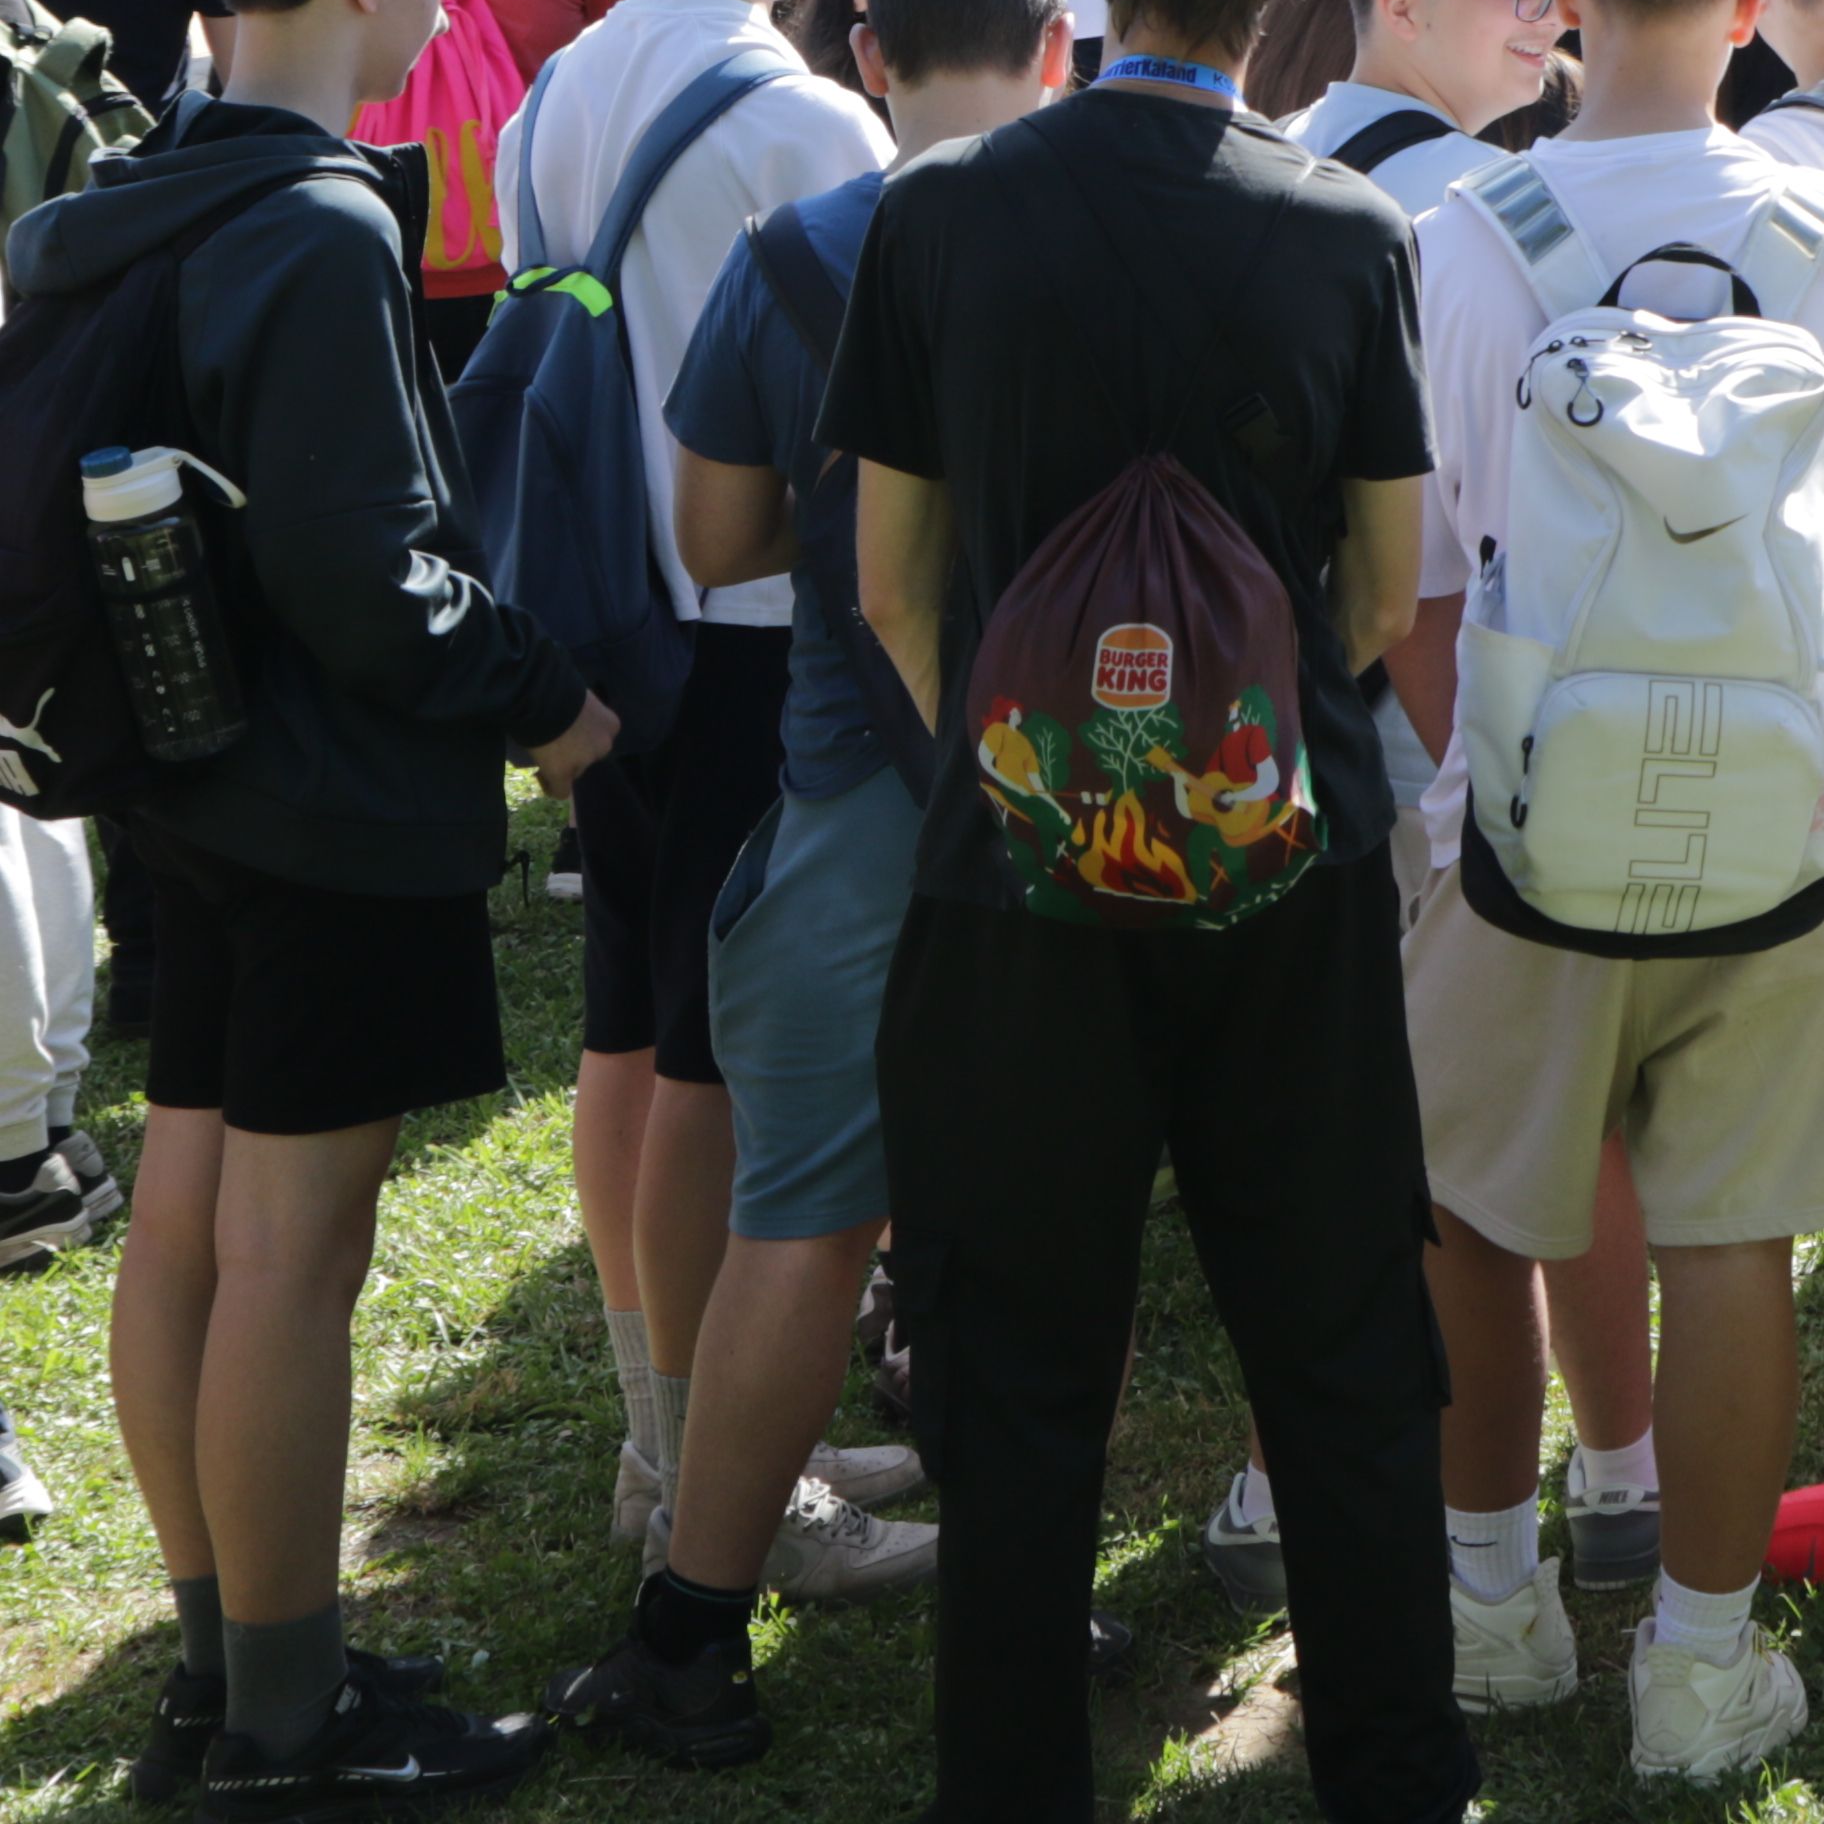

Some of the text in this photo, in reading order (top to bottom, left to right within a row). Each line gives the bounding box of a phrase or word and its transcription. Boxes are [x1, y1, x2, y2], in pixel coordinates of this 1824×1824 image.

[1100, 648, 1169, 669] BURGER
[1096, 666, 1167, 692] KING
[1614, 679, 1722, 936] ELITE
